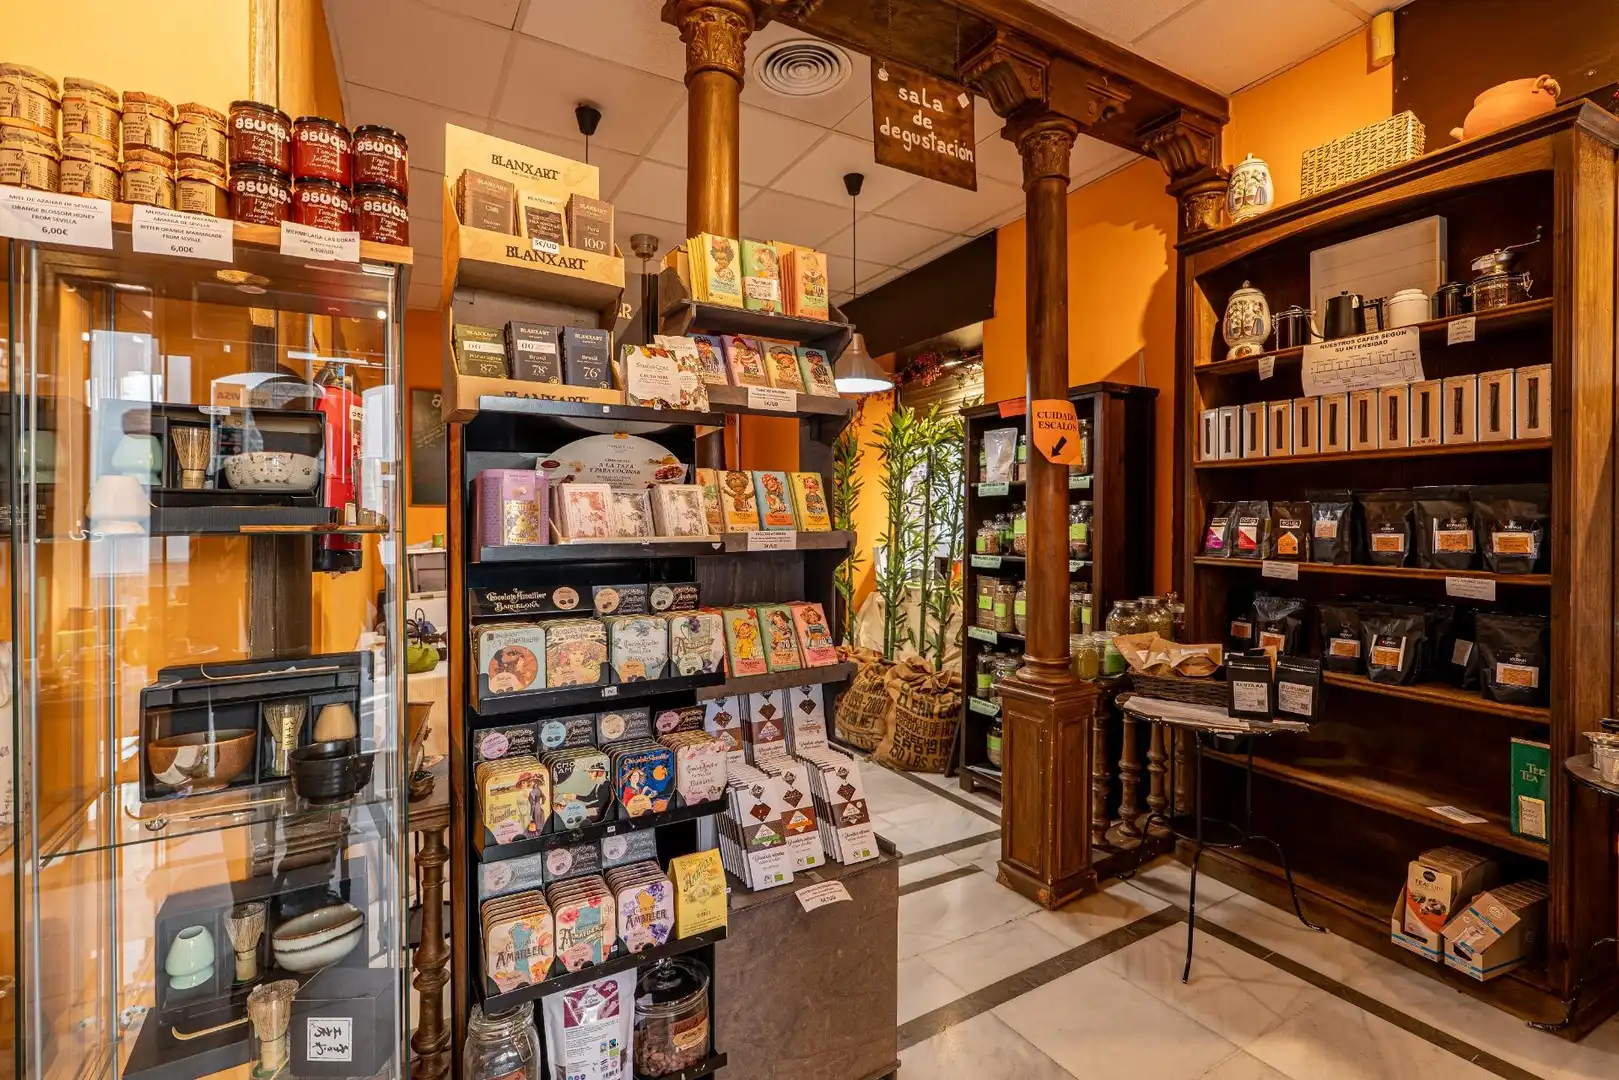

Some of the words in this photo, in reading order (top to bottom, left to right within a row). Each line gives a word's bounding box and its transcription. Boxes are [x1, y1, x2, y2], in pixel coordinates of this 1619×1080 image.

[912, 109, 933, 130] de
[879, 116, 974, 163] degustación
[491, 154, 561, 181] BLANXART
[477, 178, 508, 191] BLANXART
[37, 198, 62, 206] AZAHAR
[12, 204, 39, 212] ORANGE
[41, 208, 71, 217] BLOSSOM
[72, 212, 95, 220] HONEY
[580, 203, 607, 215] BLANXART
[52, 216, 77, 224] SEVILLA
[153, 217, 180, 225] AMARGA
[42, 226, 68, 236] 6,00€
[160, 227, 185, 235] ORANGE
[185, 230, 222, 239] MARMALADE
[286, 228, 323, 241] MERMELADA
[170, 245, 195, 254] 6,00€
[534, 240, 557, 249] 5€/UD
[505, 245, 588, 271] BLANXART
[465, 330, 498, 338] BLANXART
[520, 328, 550, 336] BLANXART
[574, 333, 603, 341] BLANXART
[1320, 338, 1355, 350] NUESTROS
[1381, 330, 1407, 339] SEGÚN
[1345, 339, 1388, 351] INTENSIDAD
[468, 353, 502, 361] Nicaragua
[494, 602, 540, 612] BARCELONA
